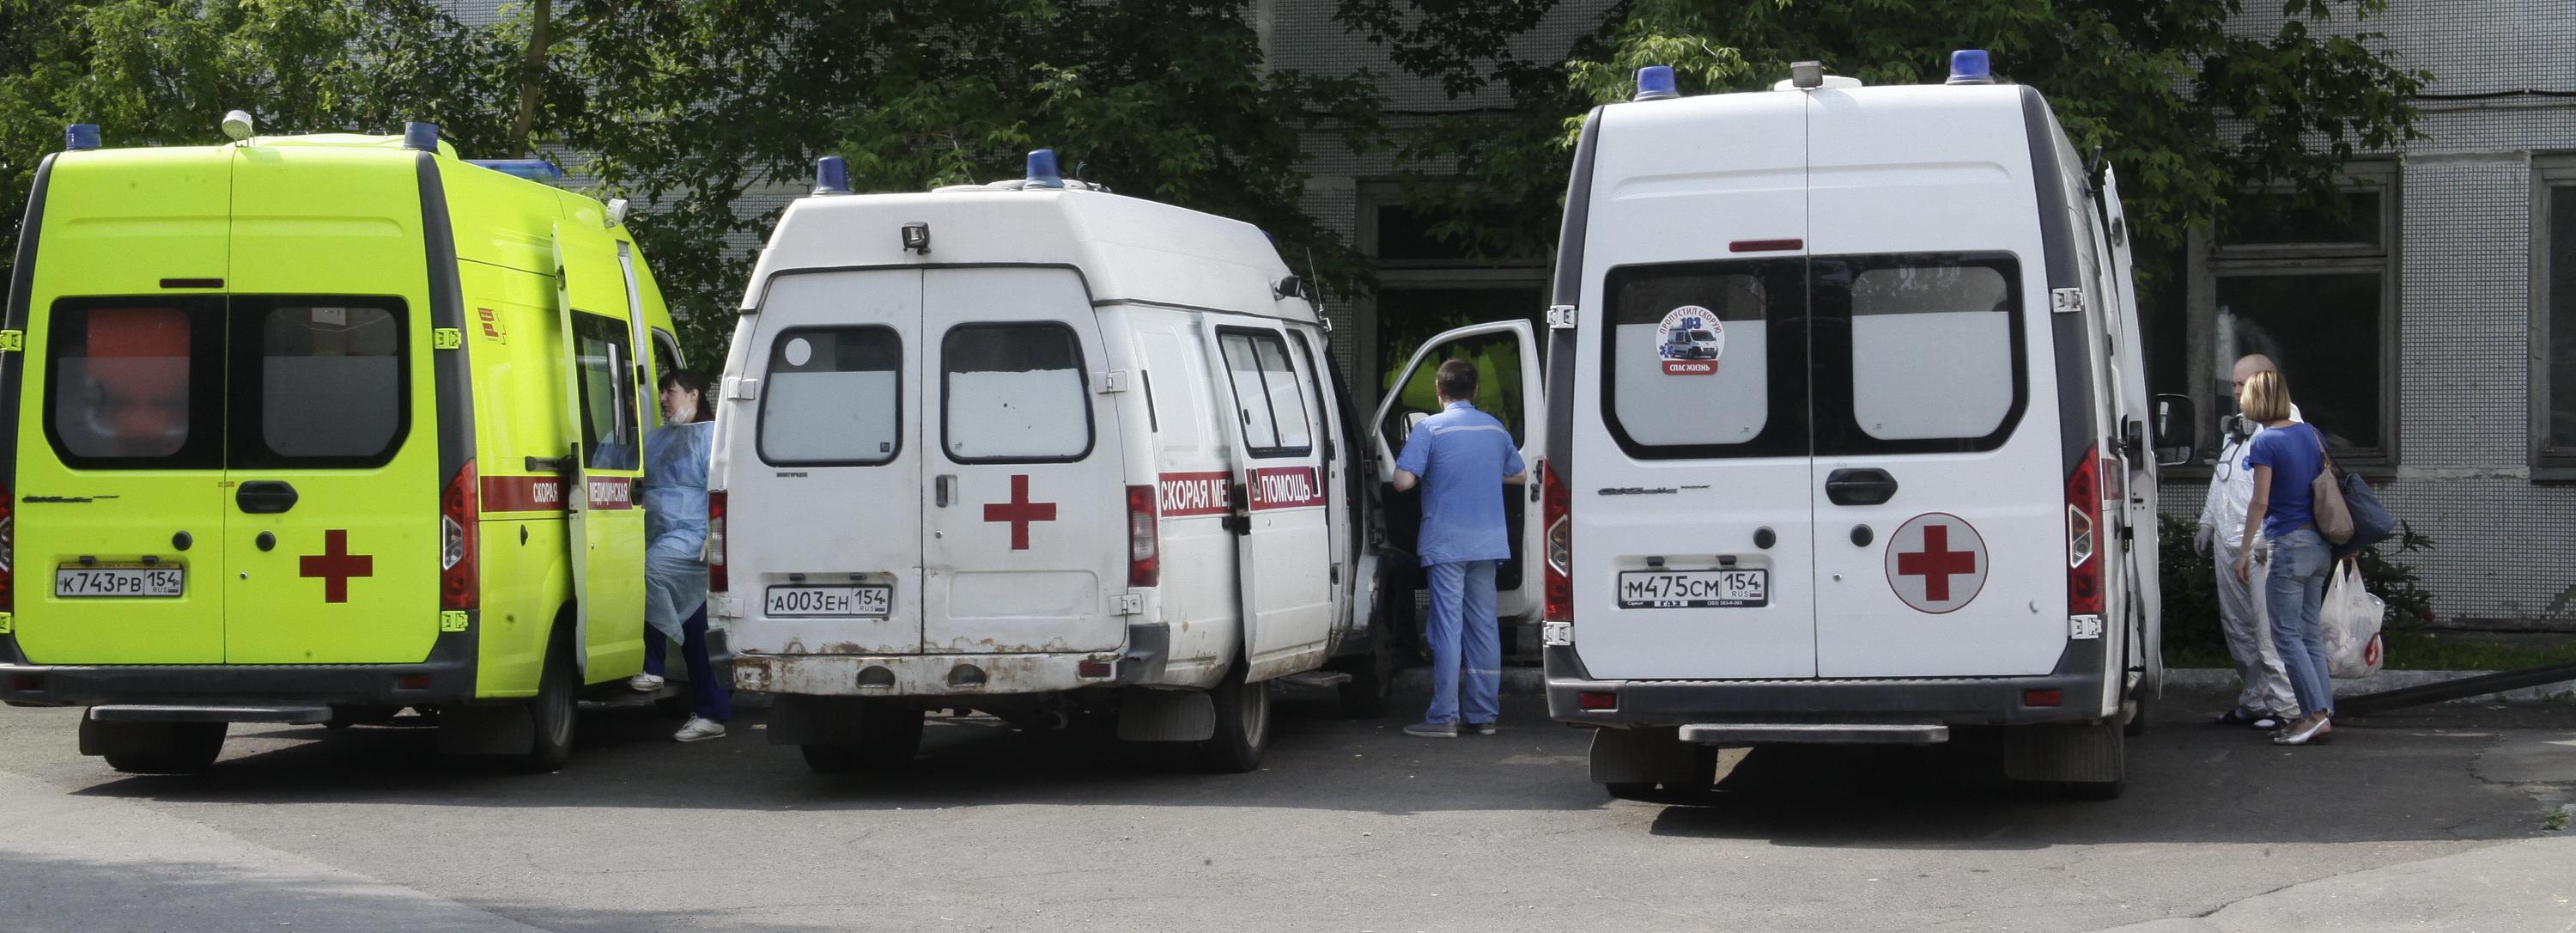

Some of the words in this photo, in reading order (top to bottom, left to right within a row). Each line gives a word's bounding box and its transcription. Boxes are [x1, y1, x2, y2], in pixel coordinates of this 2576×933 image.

[1659, 307, 1698, 335] ПРОПУСТИЛ
[1698, 309, 1722, 334] СКОРУЮ
[1680, 316, 1701, 329] 103
[1669, 363, 1686, 372] СПАС
[1686, 363, 1710, 372] ЖИЗНЬ
[532, 482, 558, 503] СКОРАЯ
[589, 482, 629, 505] МЕДИЦИНСКАЯ
[1161, 479, 1209, 511] СКОРАЯ
[1261, 473, 1310, 503] ПОМОЩЬ
[146, 571, 176, 587] 154
[1723, 573, 1761, 590] 154
[854, 589, 884, 605] 154
